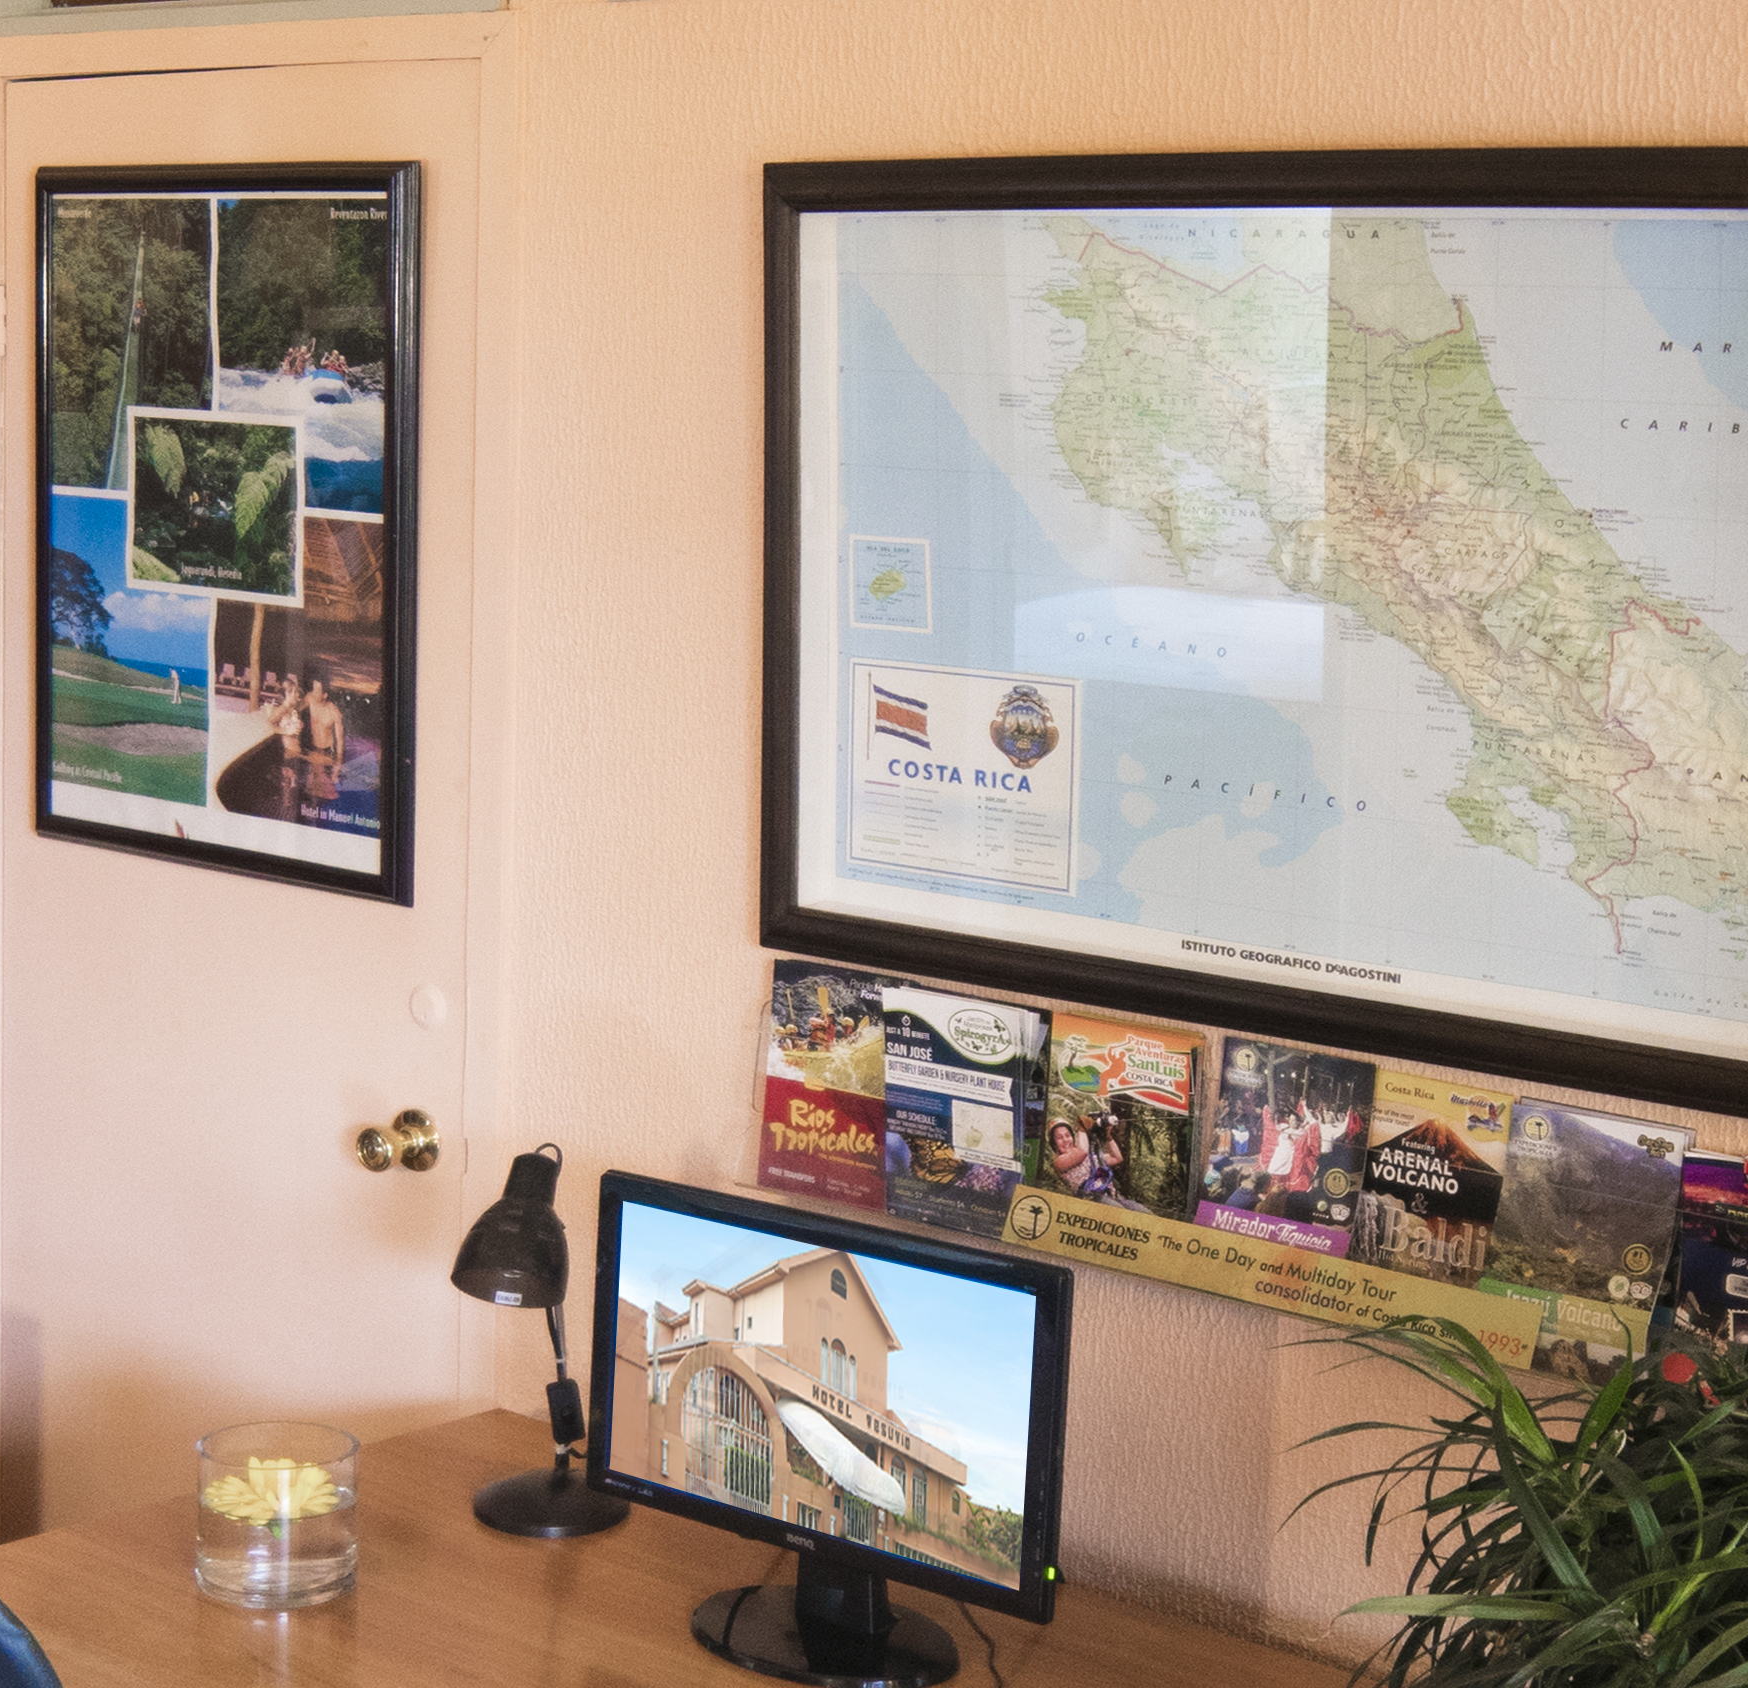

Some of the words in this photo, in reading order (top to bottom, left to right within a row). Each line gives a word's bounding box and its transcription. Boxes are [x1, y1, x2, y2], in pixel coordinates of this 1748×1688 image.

[369, 207, 389, 220] River
[1187, 228, 1381, 240] NICARAGUA
[1660, 341, 1733, 354] MAR
[1444, 547, 1509, 560] CARTAGO
[1472, 740, 1598, 763] PUNTARENAS
[887, 758, 963, 784] COSTA
[974, 769, 1033, 793] RICA
[1163, 774, 1368, 812] PACÍFICO
[301, 803, 319, 818] Hotel
[1181, 939, 1236, 957] ISTITUTO
[1239, 949, 1322, 972] GEOGRAFICO
[1325, 962, 1402, 984] DeAGOSTINI
[901, 1027, 911, 1037] 10
[886, 1041, 907, 1057] SAN
[909, 1046, 933, 1061] JOSÉ
[1127, 1036, 1163, 1051] Parque
[1134, 1047, 1187, 1065] Aventuras
[888, 1060, 917, 1075] BUTTERFLY
[918, 1065, 939, 1079] GARDEN
[945, 1072, 969, 1085] NURSERY
[970, 1076, 987, 1087] PLANT
[988, 1080, 1005, 1093] HOUSE
[1126, 1071, 1153, 1083] COSTA
[1154, 1076, 1174, 1089] RICA
[1385, 1081, 1412, 1096] Costa
[1414, 1087, 1435, 1100] Rica
[896, 1110, 907, 1119] OUR
[769, 1123, 876, 1154] Tropicales
[1402, 1137, 1435, 1155] Featuring
[1380, 1147, 1453, 1176] ARENAL
[768, 1166, 783, 1176] FREE
[784, 1170, 816, 1184] TRANSFERS
[1371, 1162, 1459, 1195] VOLCANO
[1411, 1192, 1428, 1214] &
[1212, 1208, 1276, 1239] Mirador
[1276, 1222, 1333, 1251] Tiquicia
[1379, 1203, 1487, 1271] Baldi
[1055, 1210, 1151, 1244] EXPEDICIONES
[1185, 1238, 1220, 1260] One
[1225, 1249, 1257, 1272] Day
[1259, 1261, 1284, 1277] and
[1285, 1262, 1356, 1297] Multiday
[1362, 1278, 1398, 1302] Tour
[1731, 1257, 1746, 1268] VIP
[1059, 1230, 1139, 1261] TROPICALES
[1255, 1280, 1355, 1313] consolidator
[1355, 1305, 1370, 1318] of
[1409, 1318, 1436, 1336] Rica
[1557, 1298, 1625, 1333] Volcano
[812, 1384, 852, 1419] HOTEL
[866, 1413, 911, 1450] VESUVIO
[786, 1533, 815, 1549] BenQ
